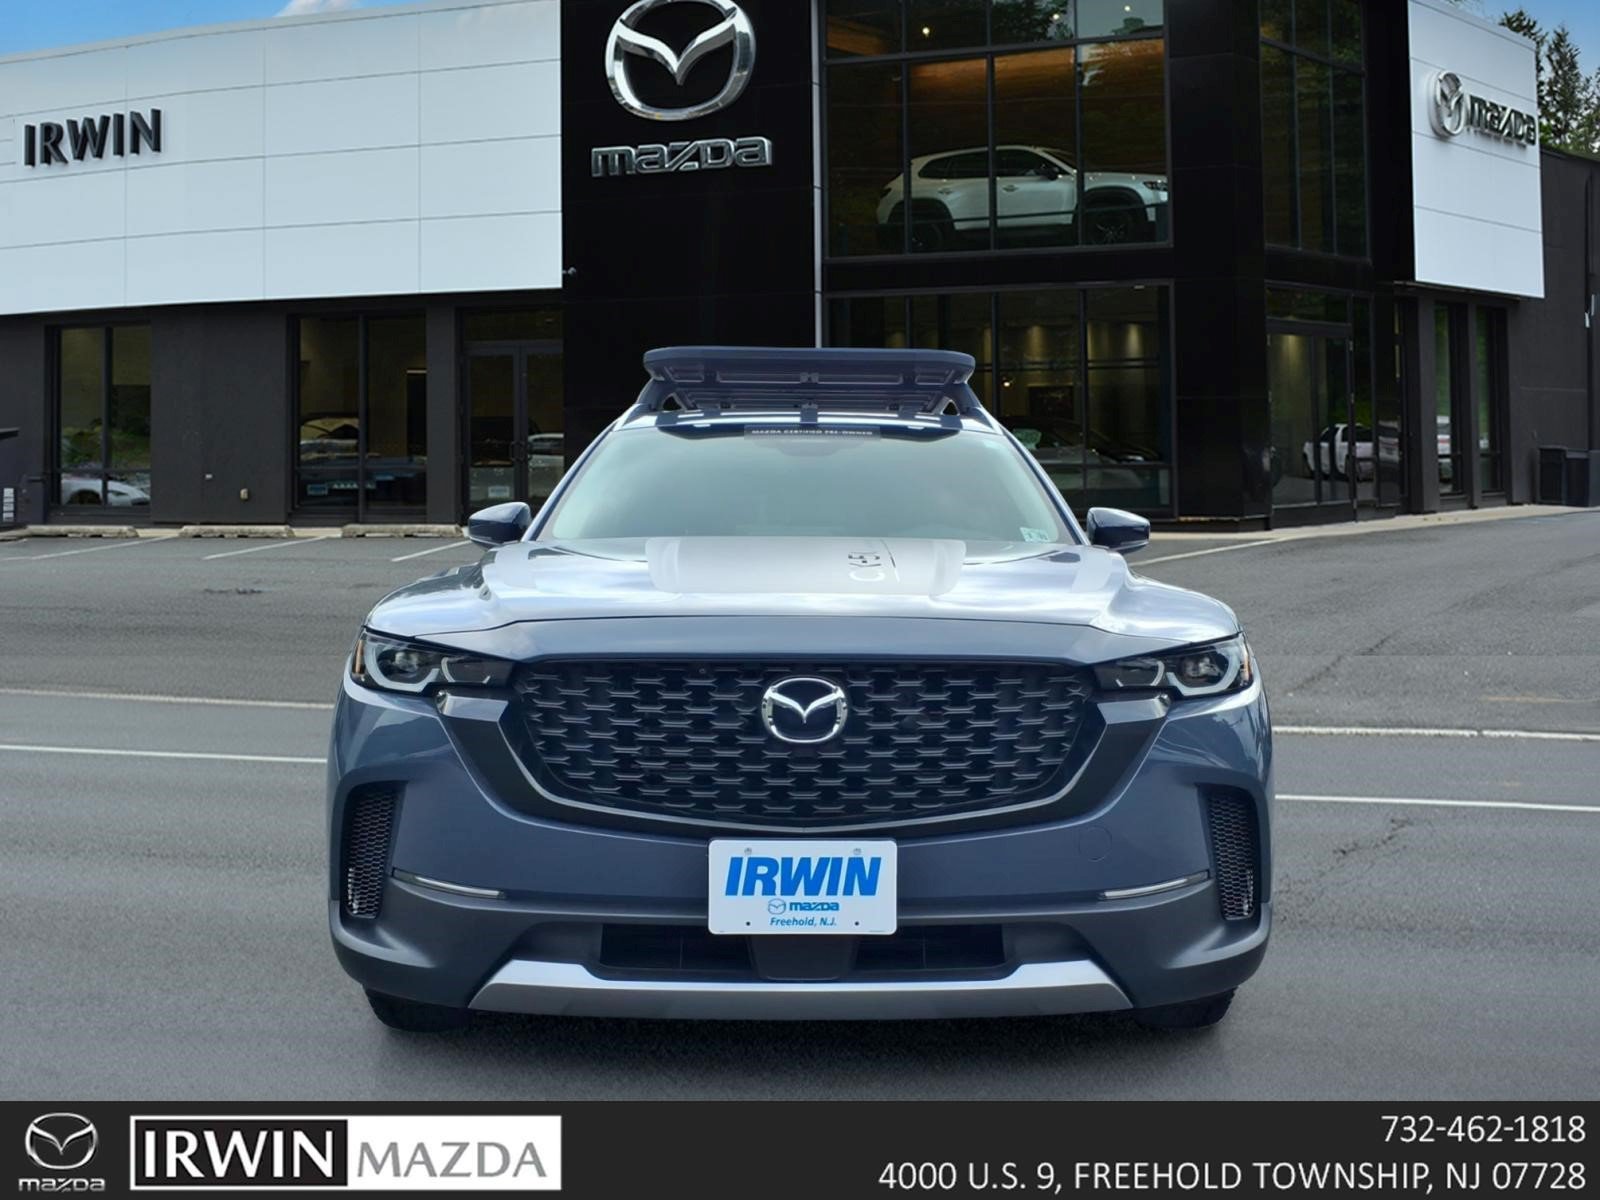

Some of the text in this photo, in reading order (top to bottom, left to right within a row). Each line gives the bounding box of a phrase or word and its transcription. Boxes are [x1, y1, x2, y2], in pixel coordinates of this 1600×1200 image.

[25, 109, 162, 167] IRWIN
[591, 136, 773, 178] mazda
[725, 857, 882, 896] IRWIN
[769, 917, 837, 927] Freehold, N.J.
[789, 902, 840, 911] mazda
